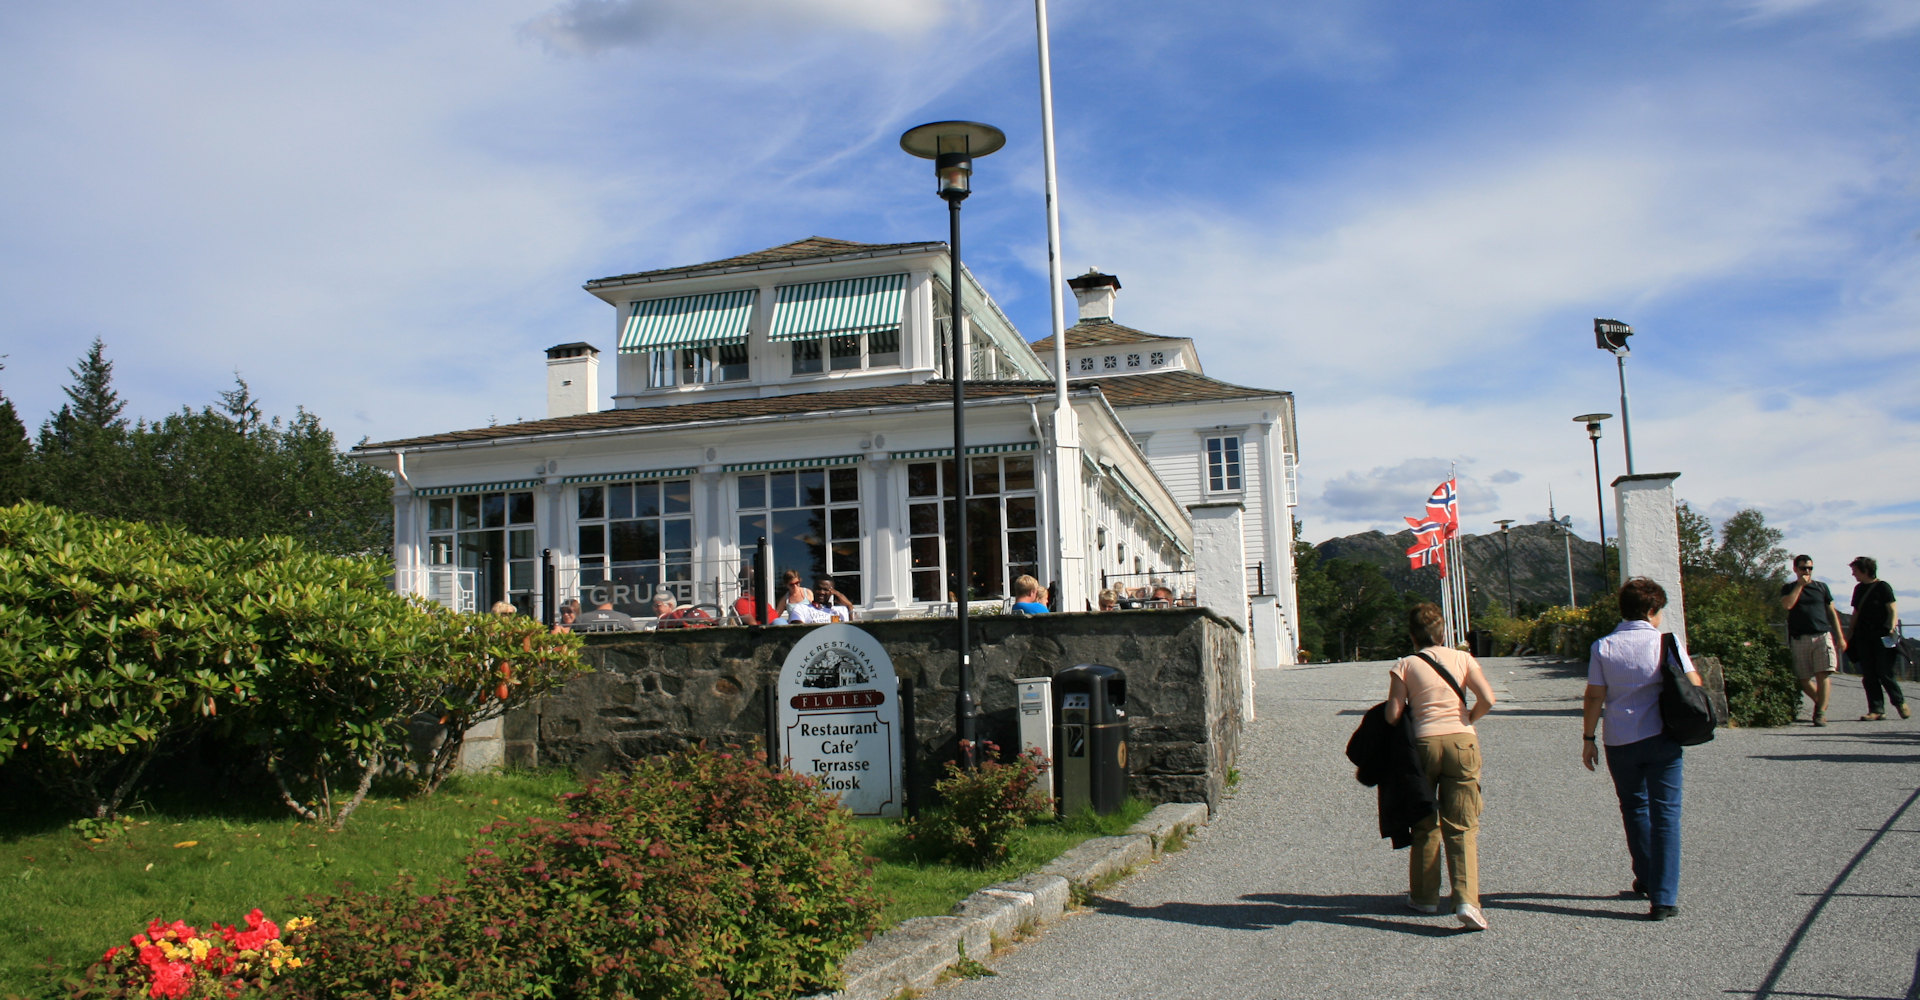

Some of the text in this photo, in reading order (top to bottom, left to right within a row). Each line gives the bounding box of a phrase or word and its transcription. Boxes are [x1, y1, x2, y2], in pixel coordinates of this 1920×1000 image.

[795, 641, 878, 685] FOLKERESTAURANT
[802, 693, 873, 707] FLØIEN
[801, 721, 878, 736] Restaurant
[812, 758, 870, 772] Terrasse
[821, 776, 861, 790] Kiosk
